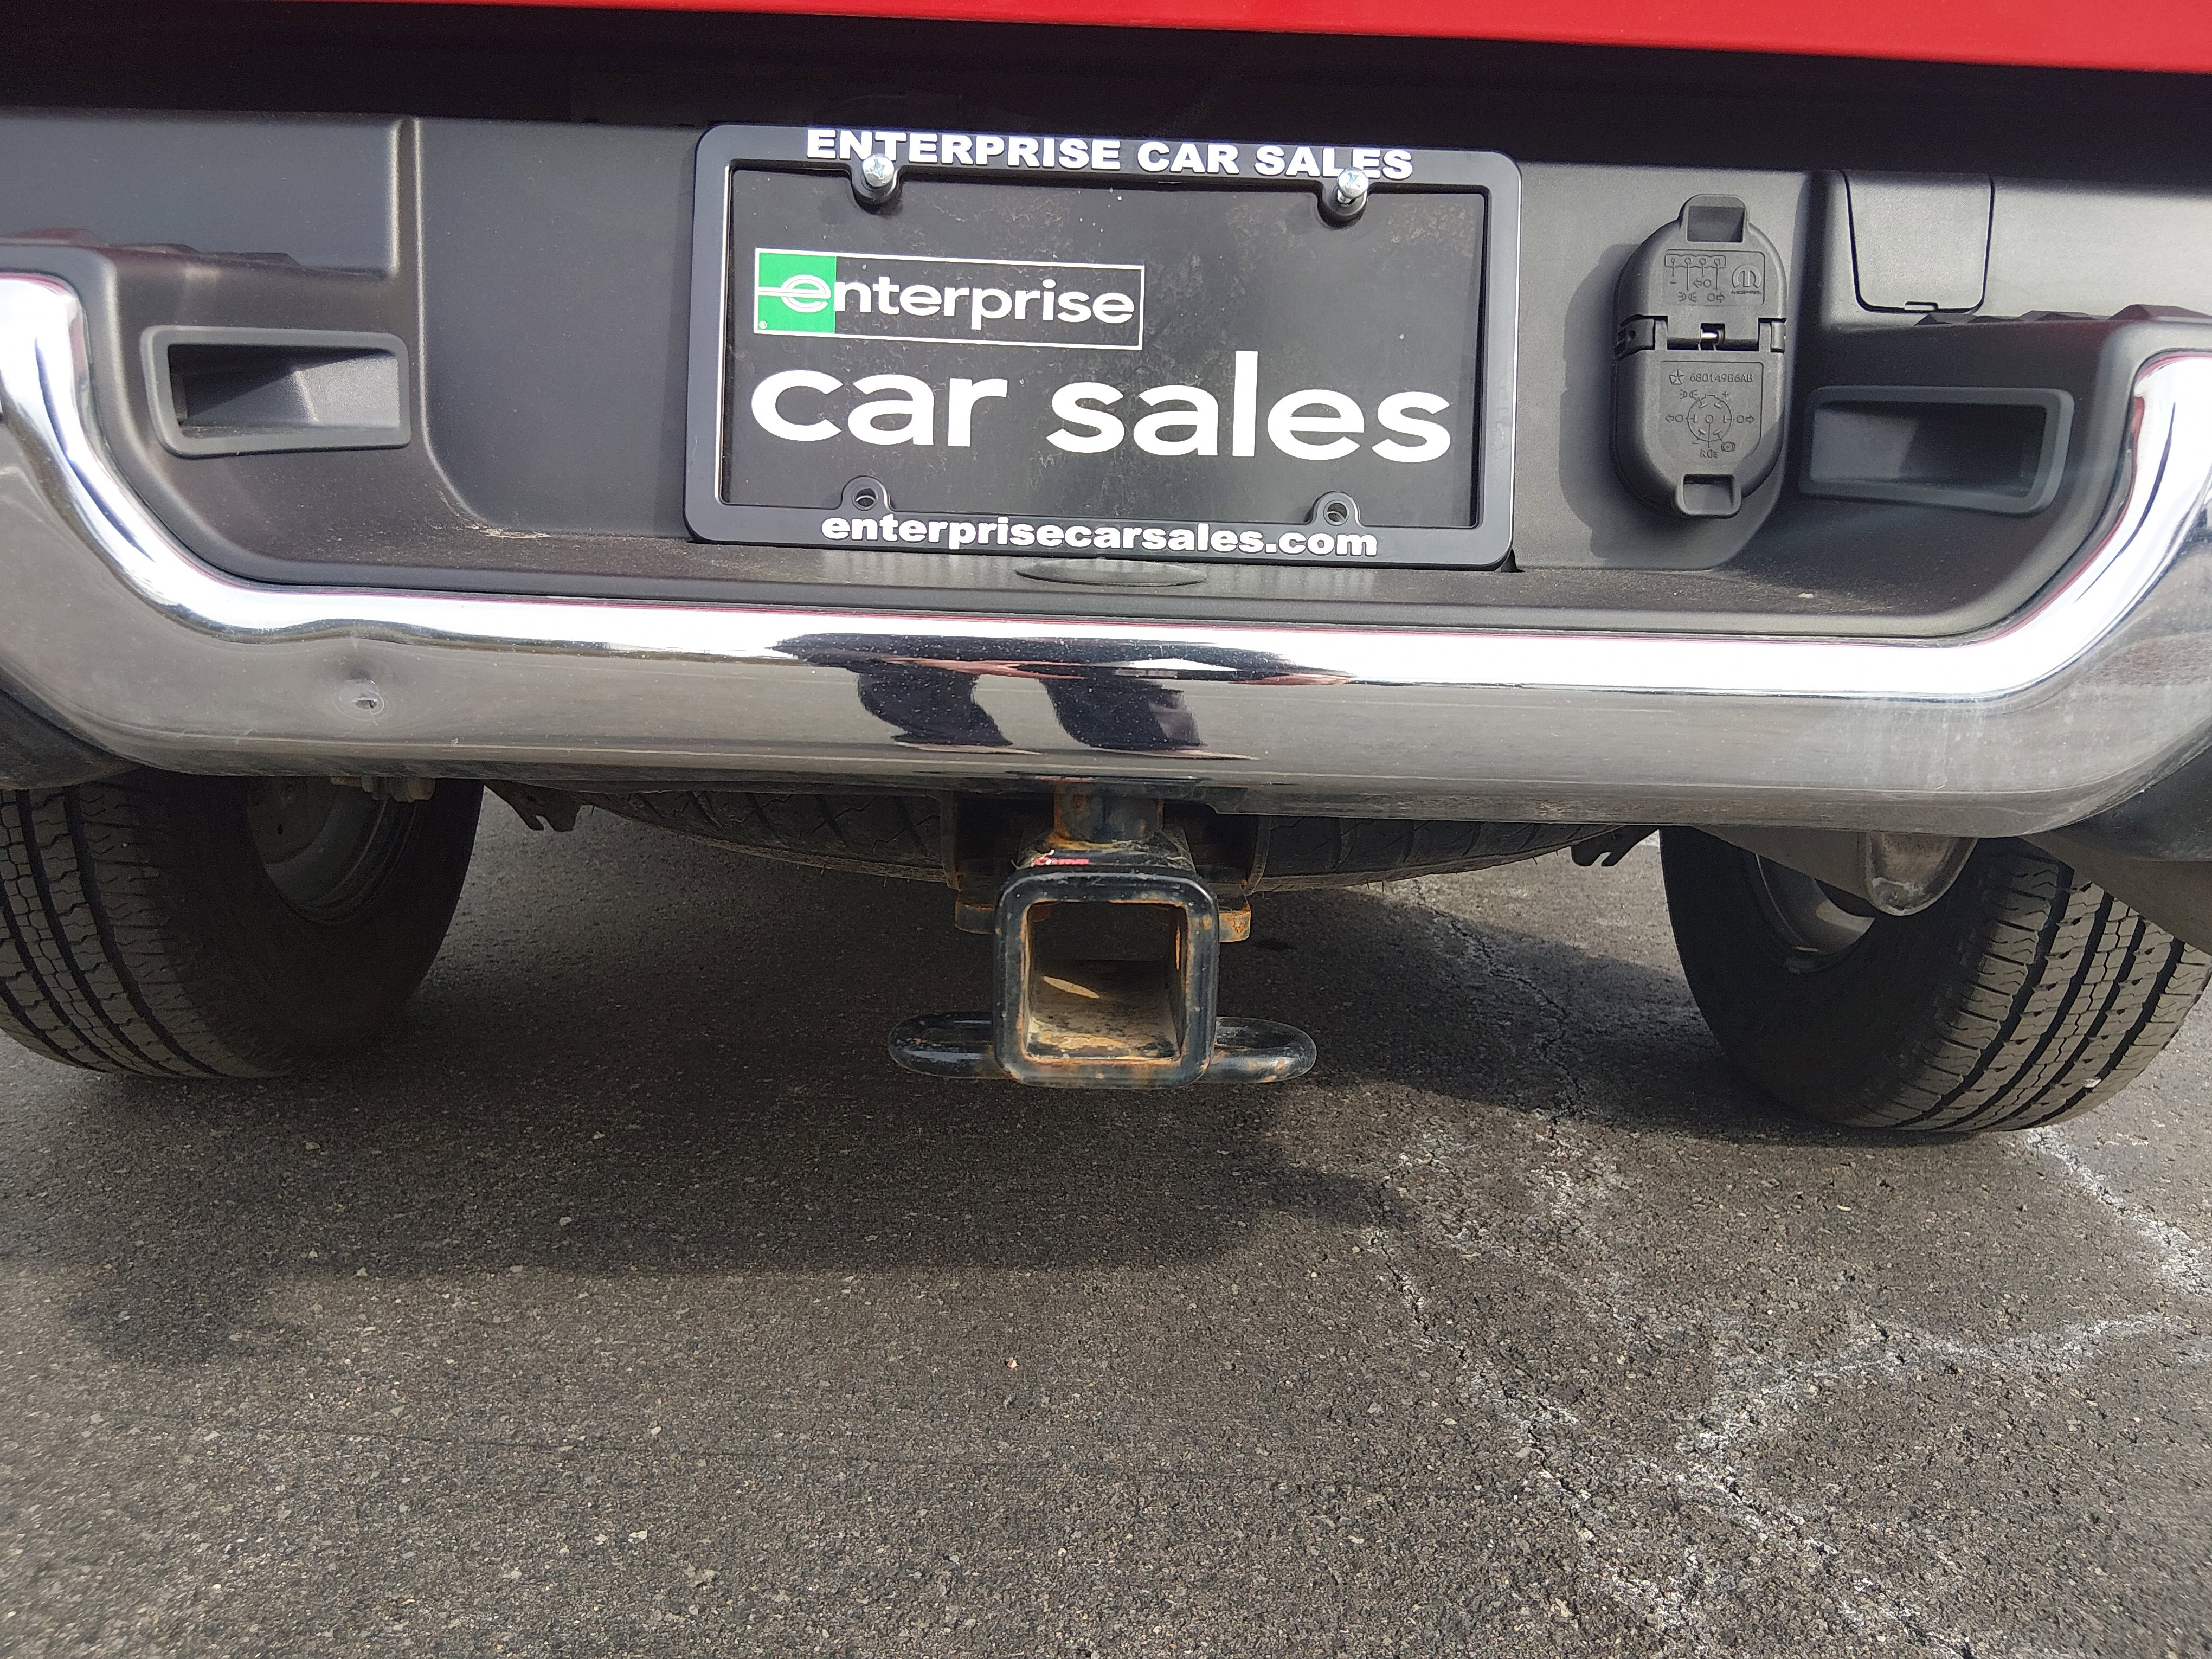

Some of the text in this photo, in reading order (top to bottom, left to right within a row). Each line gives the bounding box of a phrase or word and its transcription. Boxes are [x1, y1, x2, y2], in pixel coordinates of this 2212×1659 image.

[807, 130, 1413, 179] ENTERPRISE CAR SALES
[780, 275, 1135, 330] enterprise
[751, 350, 1451, 462] car sales
[821, 513, 1377, 557] enterprisecarsales.com
